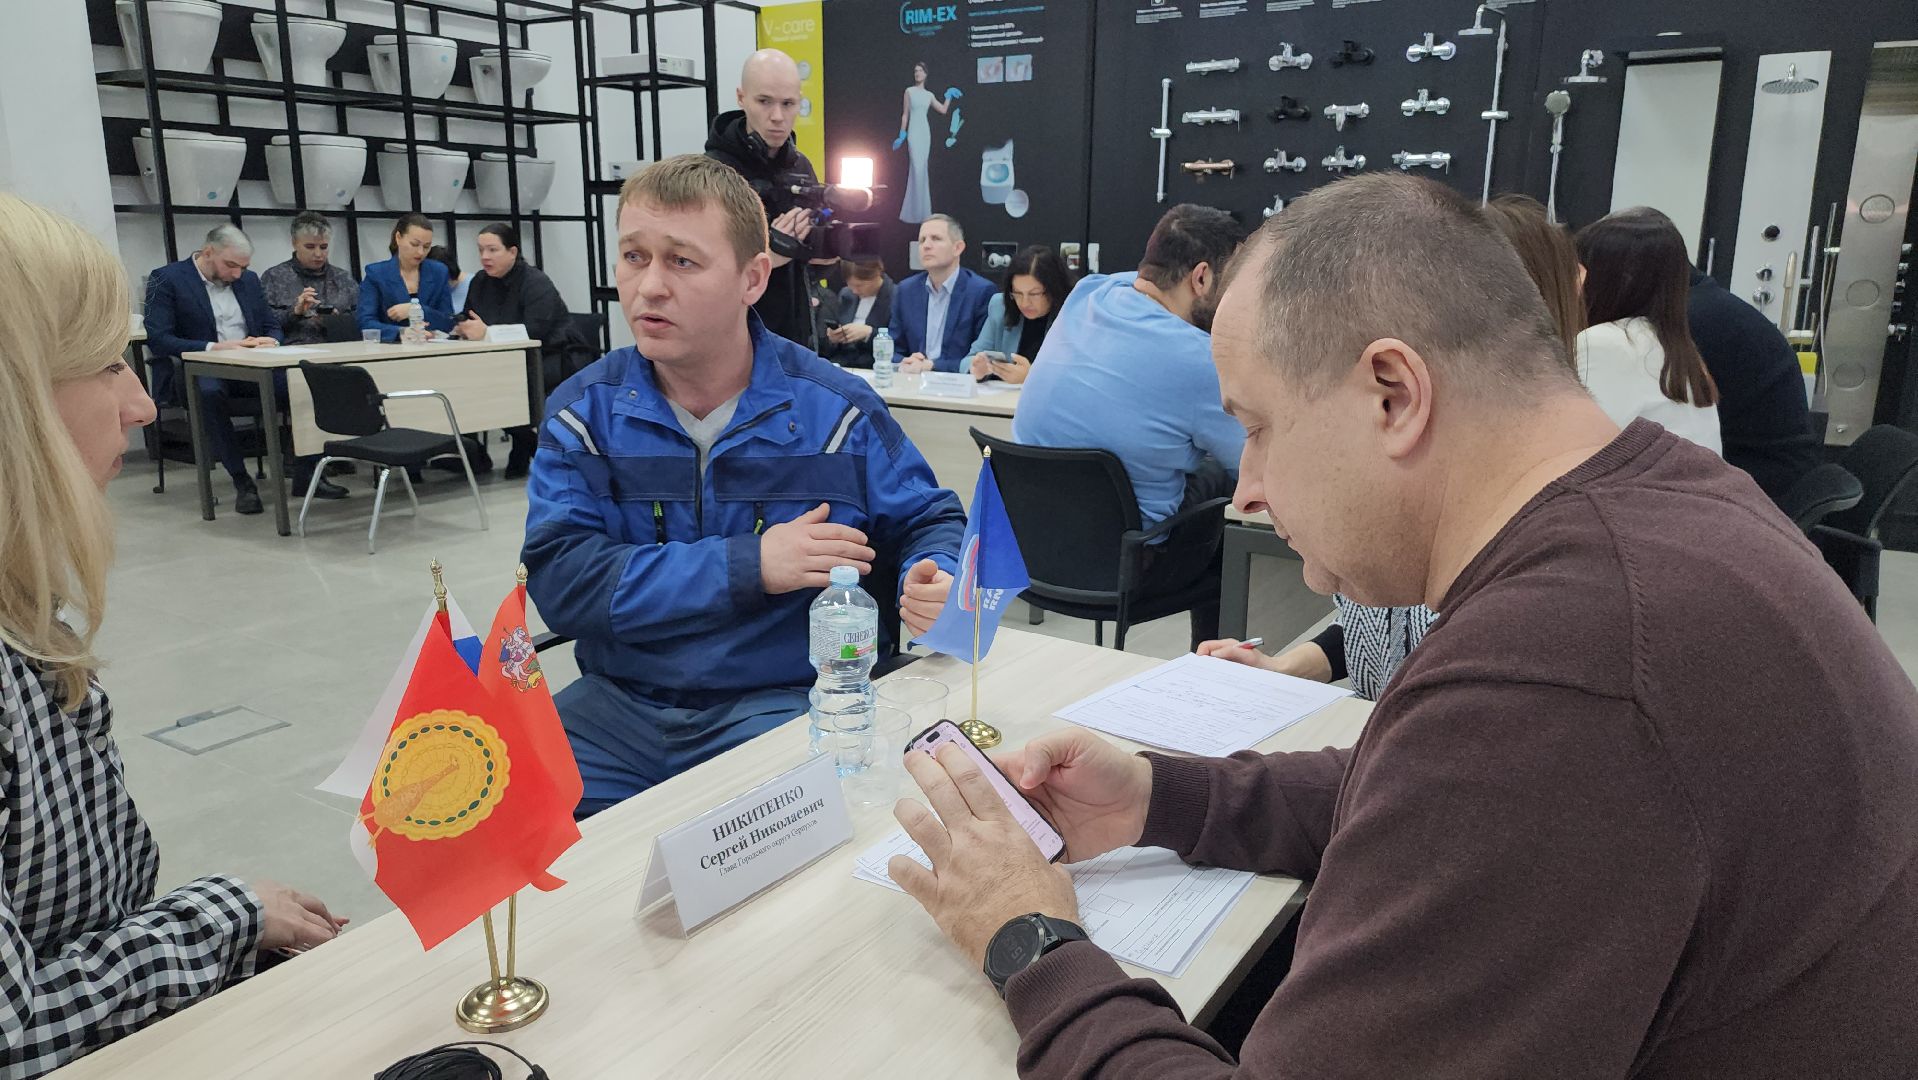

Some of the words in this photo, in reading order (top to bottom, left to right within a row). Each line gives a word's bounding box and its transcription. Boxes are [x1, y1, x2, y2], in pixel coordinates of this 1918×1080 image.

[905, 5, 957, 25] RIM-EX
[700, 835, 749, 870] Сергей
[749, 797, 825, 846] Николаевич
[712, 785, 804, 842] НИКИТЕНКО
